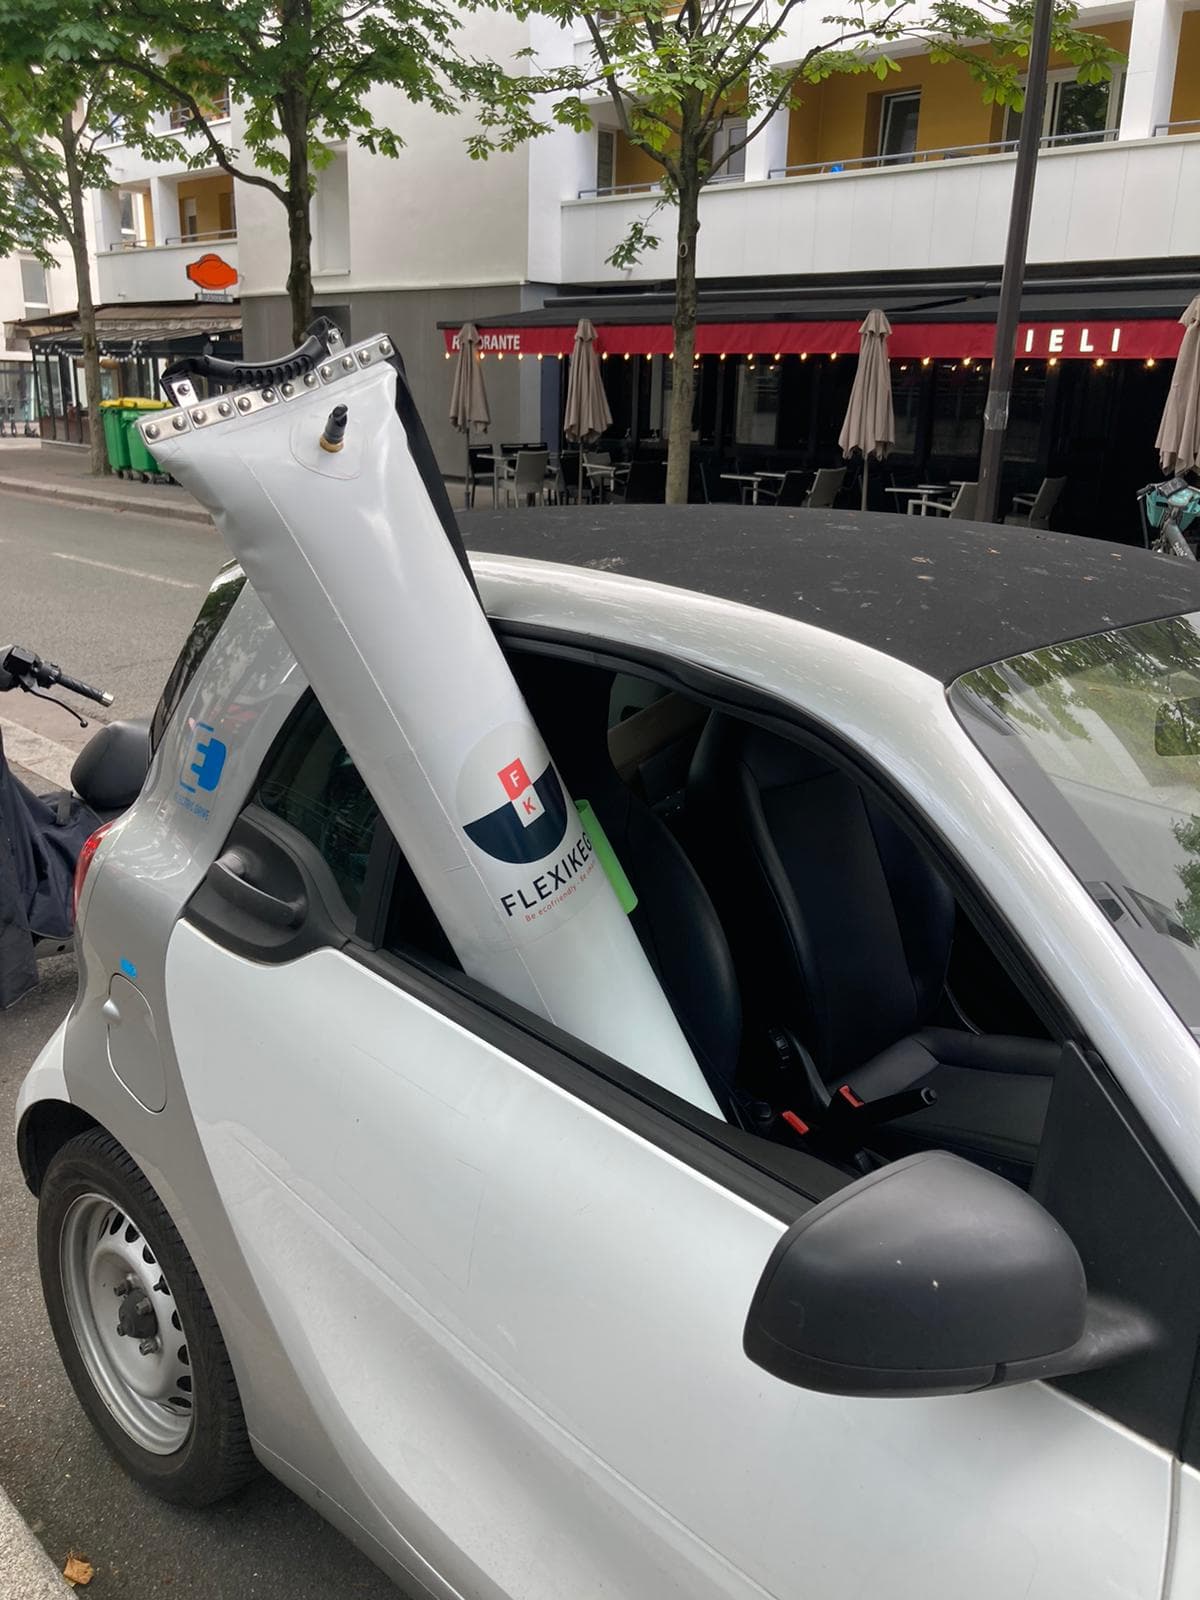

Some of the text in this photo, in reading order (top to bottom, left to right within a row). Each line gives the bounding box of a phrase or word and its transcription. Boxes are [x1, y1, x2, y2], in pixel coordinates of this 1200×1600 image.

[1025, 329, 1120, 352] IELI
[510, 770, 520, 788] F
[522, 796, 537, 815] K
[500, 832, 592, 917] FLEXIKEG
